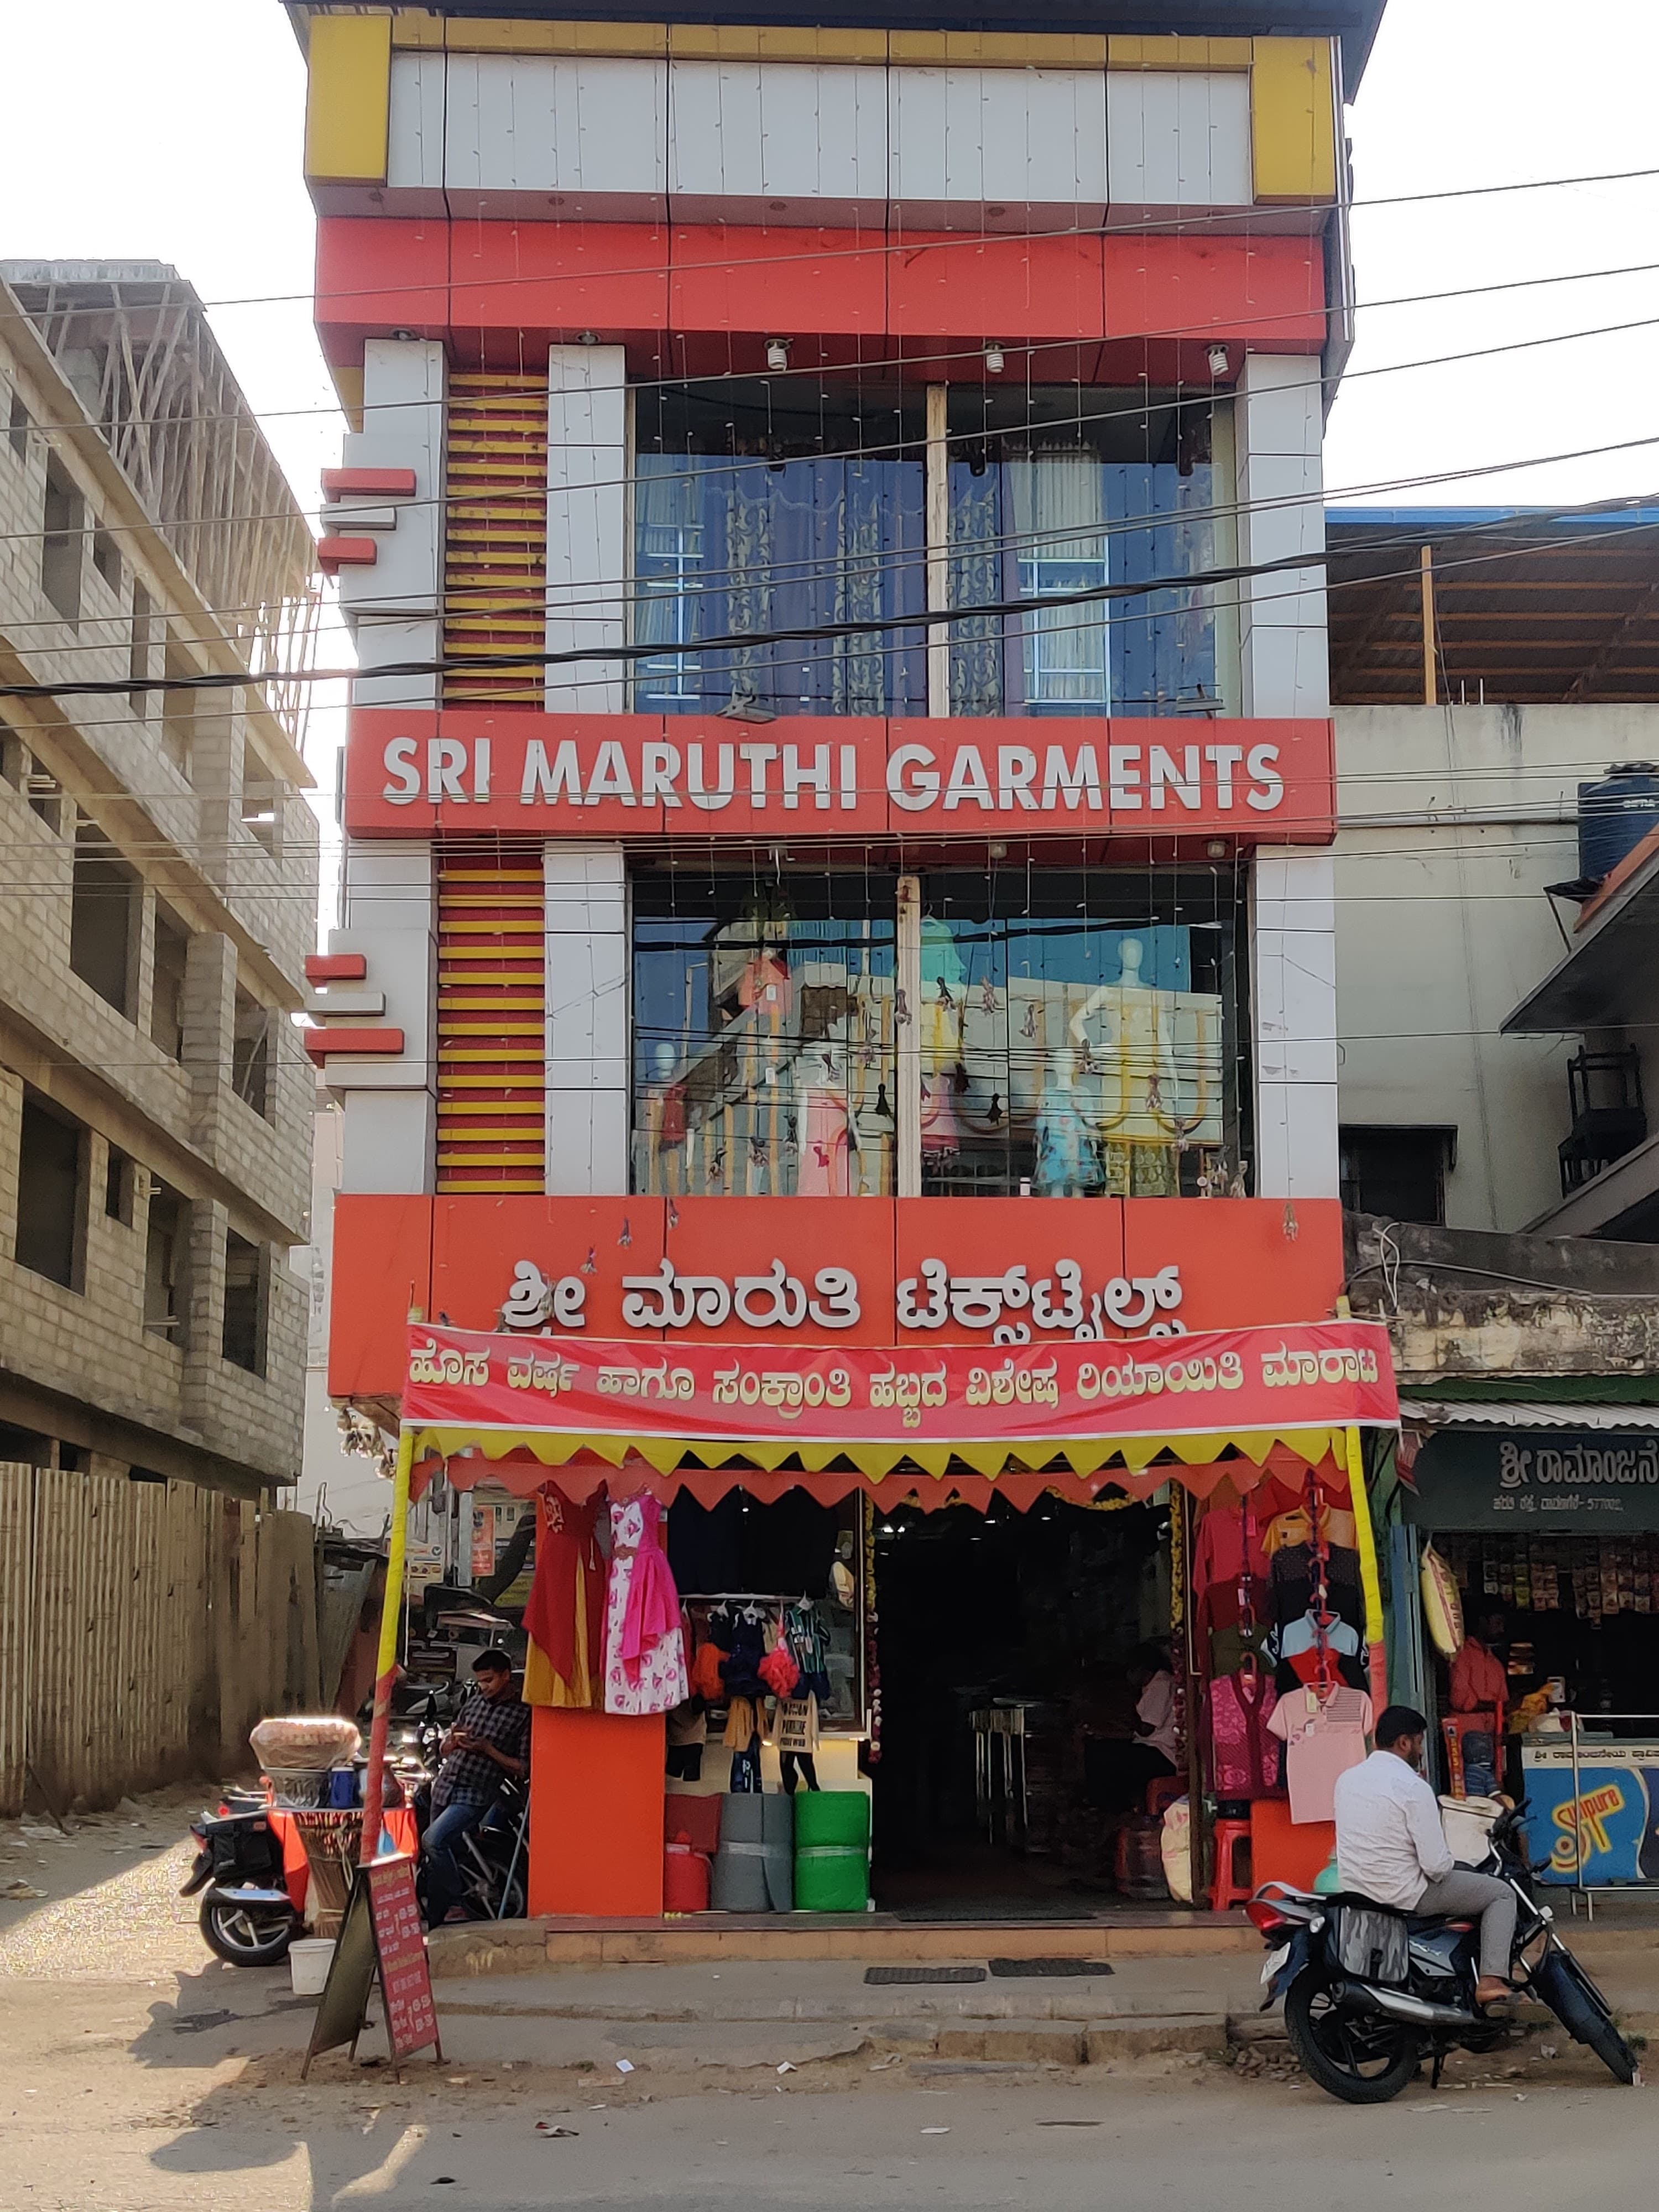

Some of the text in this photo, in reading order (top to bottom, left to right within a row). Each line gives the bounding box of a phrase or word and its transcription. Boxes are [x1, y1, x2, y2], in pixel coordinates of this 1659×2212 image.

[383, 737, 1285, 811] SRI MARUTHI GARMENTS
[622, 1258, 861, 1328] ಮಾರುತಿ
[409, 1338, 1379, 1428] ಹೊಸ ವರ್ಷ ಹಾಗೂ ಸಂಕ್ರಾಂತಿ ಹಬ್ಬದ ವಿಶೇಷ ರಿಯಾಯಿತಿ ಮಾರಾಟ
[1499, 1441, 1532, 1488] ಶ್ರೀ
